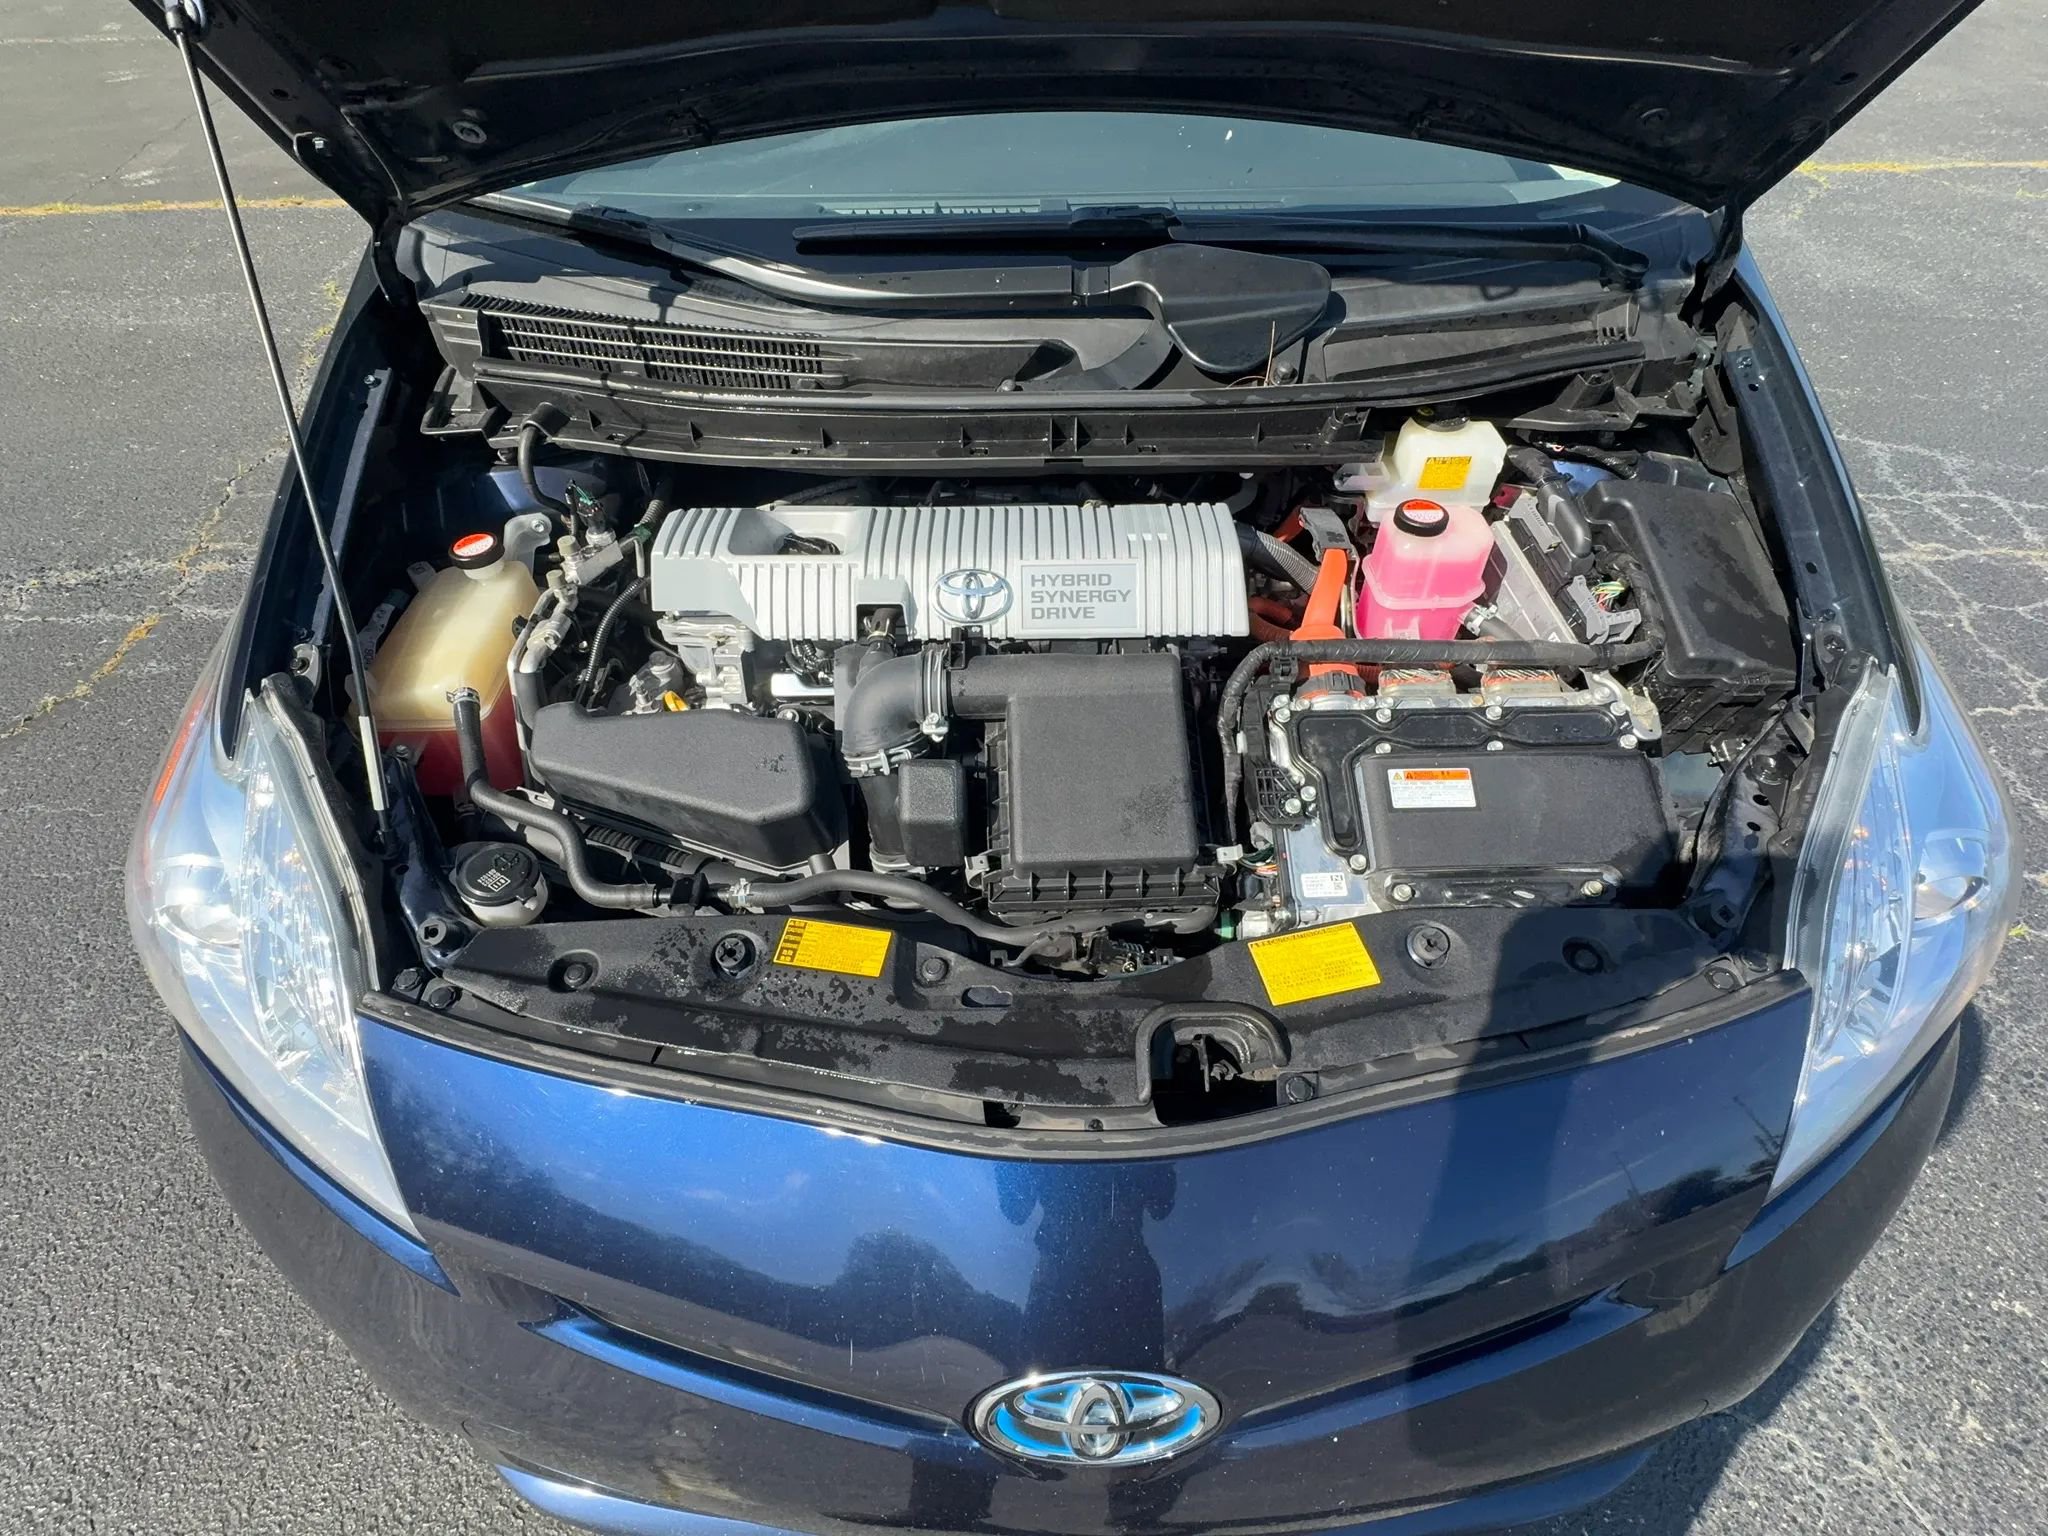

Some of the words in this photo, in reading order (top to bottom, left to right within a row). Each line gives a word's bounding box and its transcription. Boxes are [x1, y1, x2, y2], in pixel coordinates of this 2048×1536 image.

[1031, 574, 1112, 587] HYBRID
[1031, 590, 1131, 603] SYNERGY
[1031, 607, 1095, 620] DRIVE
